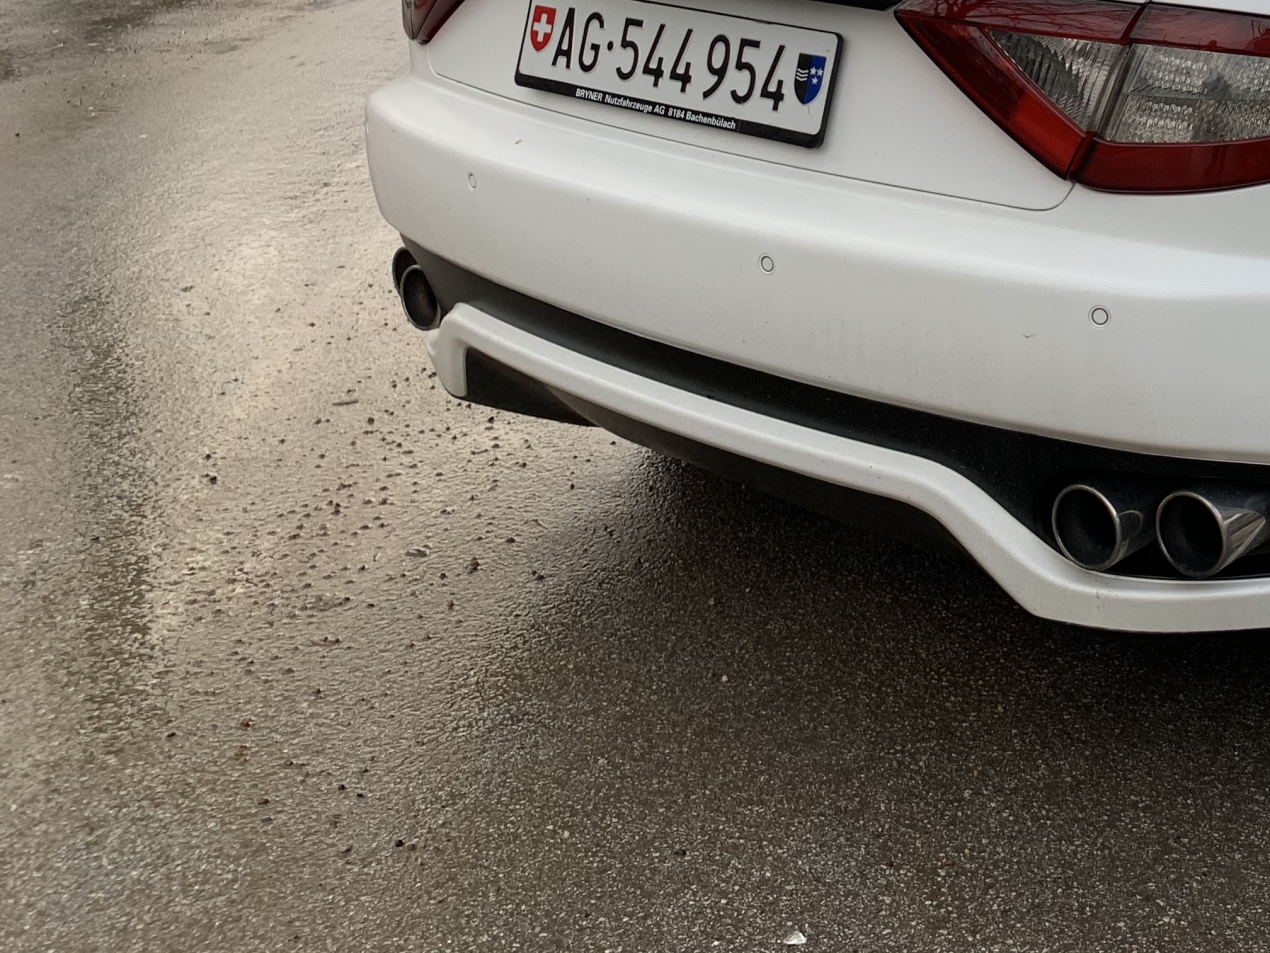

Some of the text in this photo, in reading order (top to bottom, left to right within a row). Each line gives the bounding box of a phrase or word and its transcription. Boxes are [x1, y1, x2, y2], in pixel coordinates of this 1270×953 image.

[575, 87, 736, 130] BRYNER Nutzfahrzeuge AG 8184 Bachenbülach
